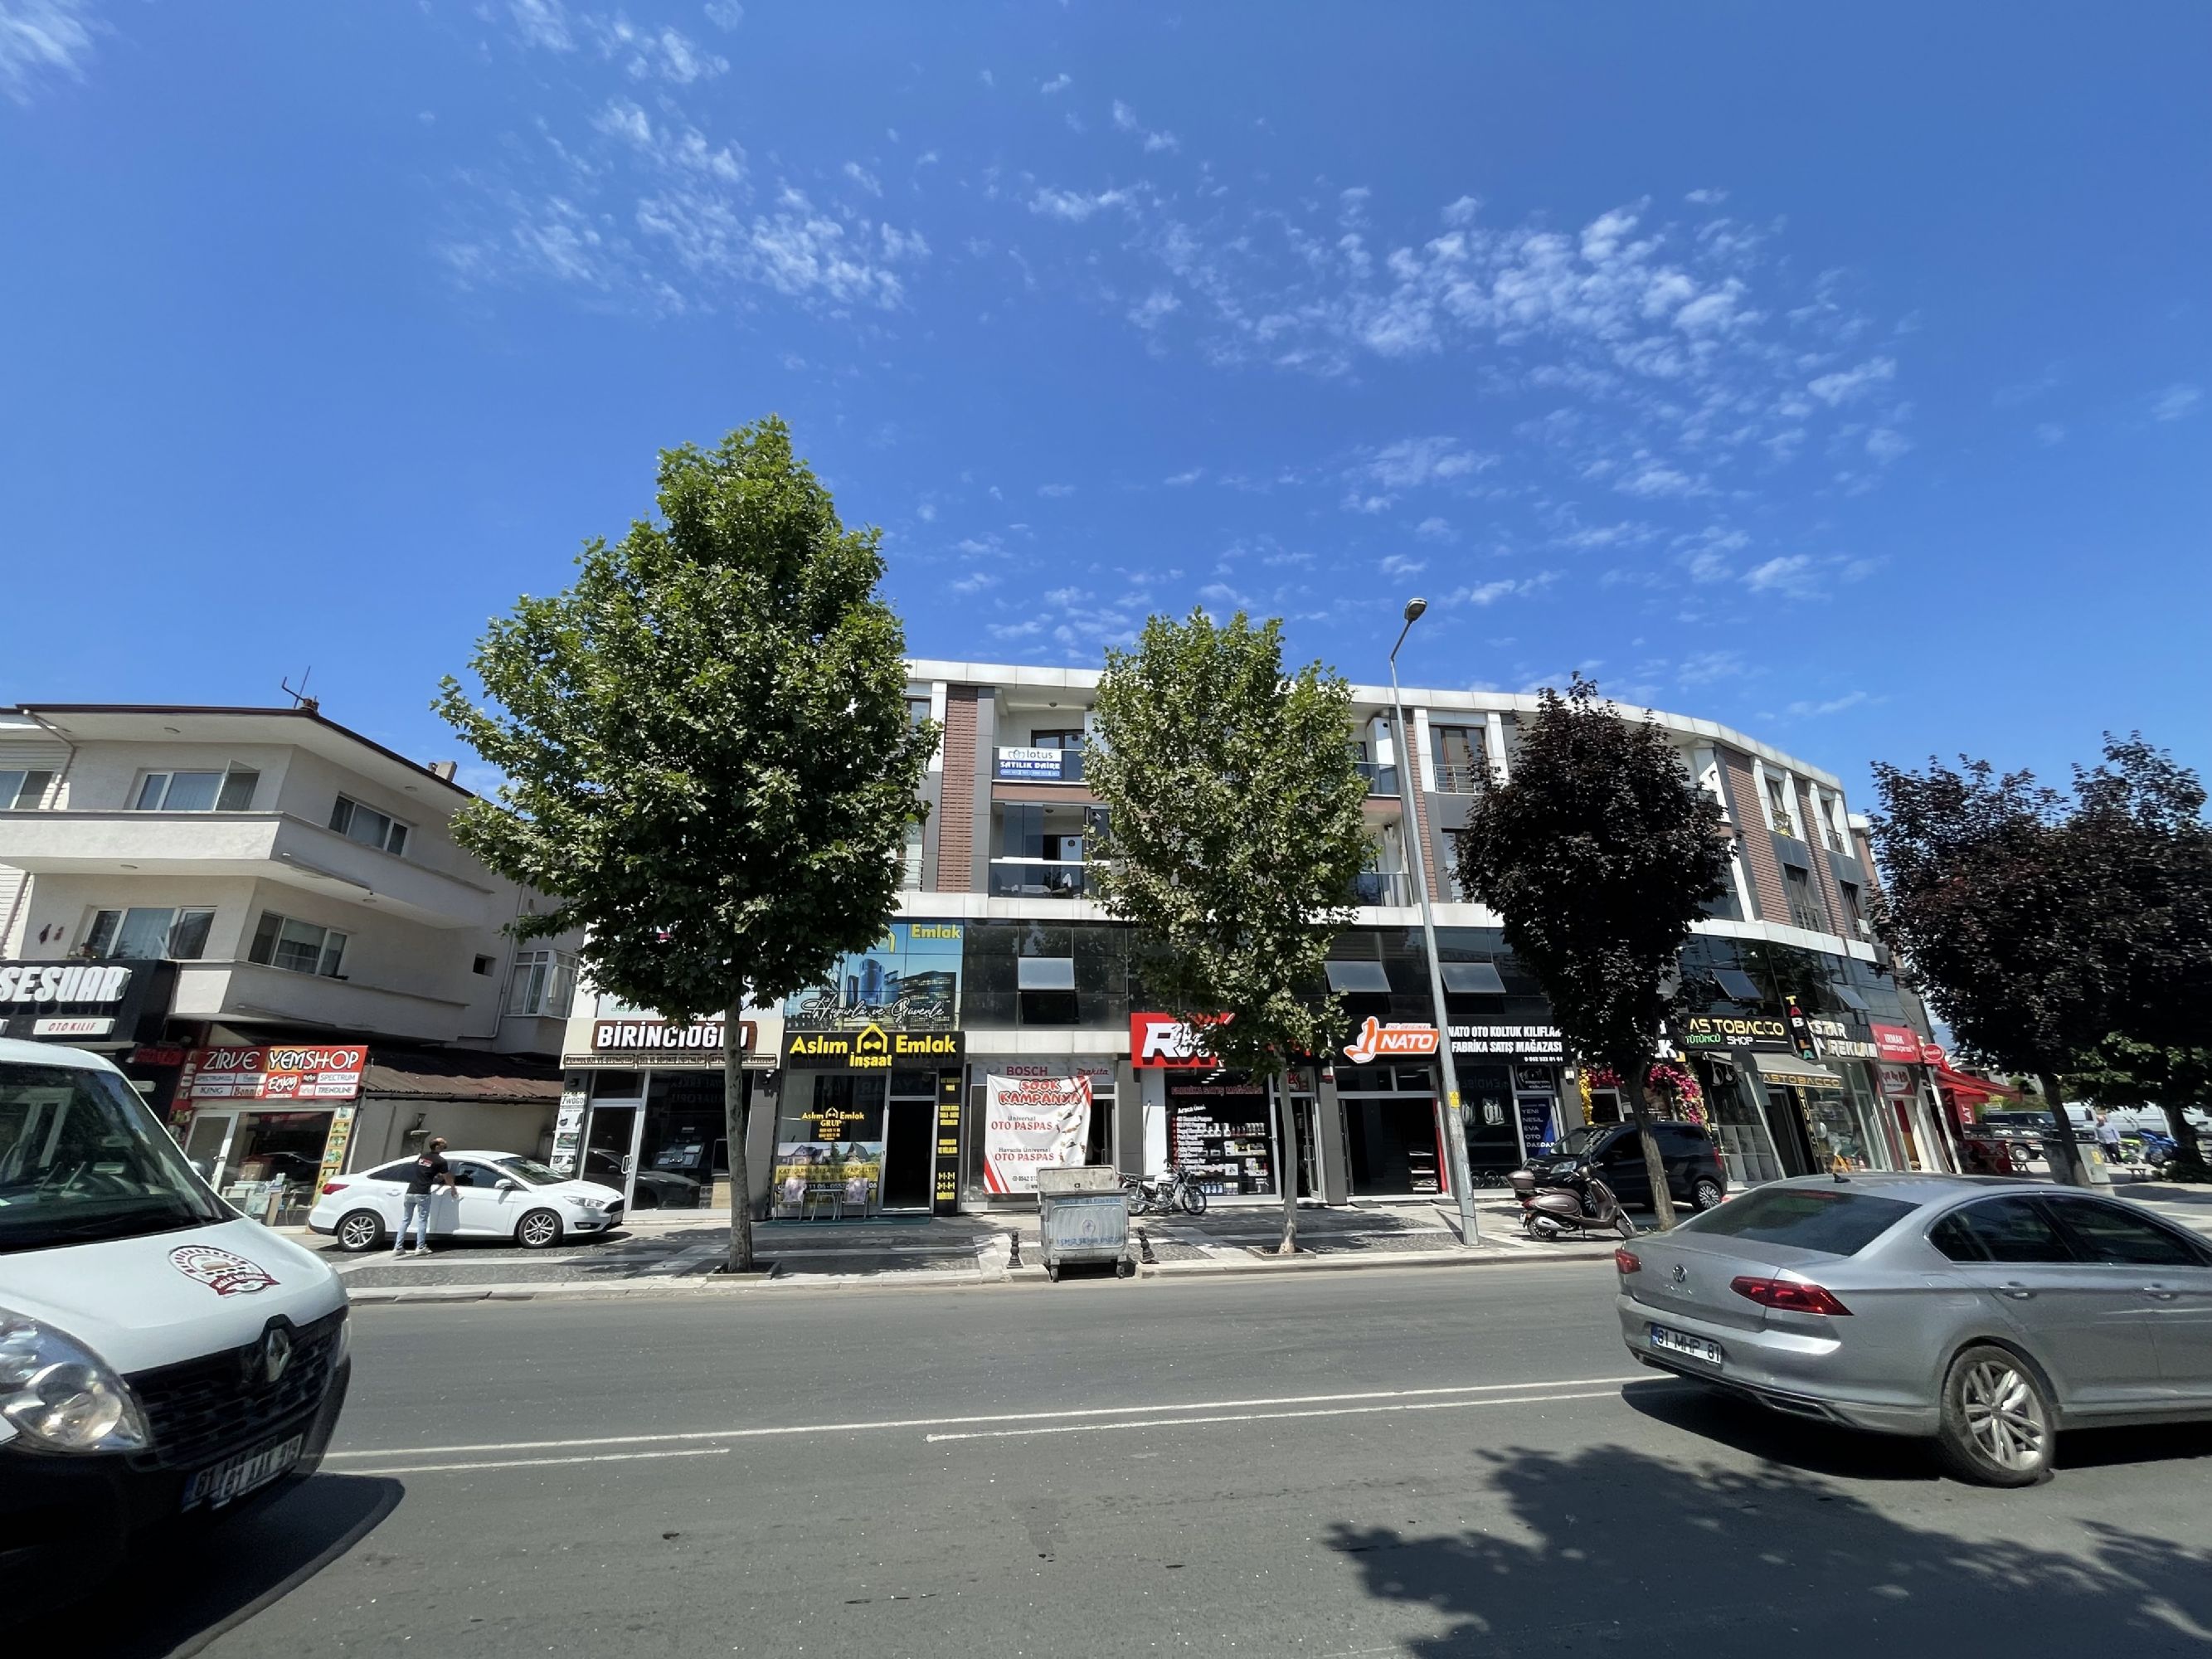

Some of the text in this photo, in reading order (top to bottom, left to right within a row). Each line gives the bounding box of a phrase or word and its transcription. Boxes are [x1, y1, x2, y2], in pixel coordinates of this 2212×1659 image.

[1027, 751, 1053, 759] lotus
[911, 923, 962, 939] Emlak
[871, 1006, 886, 1016] ve
[48, 1023, 68, 1031] OTO
[1471, 1026, 1489, 1037] OTO
[1490, 1026, 1522, 1037] KOLTUK
[1689, 1018, 1785, 1036] AS TOBACCO
[790, 1034, 957, 1054] Aslım Emlak
[1380, 1034, 1434, 1049] NATO
[1451, 1039, 1563, 1053] FABRİKA SATIŞ MAĞAZASI
[1727, 1036, 1754, 1046] SHOP
[203, 1048, 260, 1070] ZİRVE
[268, 1050, 360, 1070] YEMSHOP
[849, 1051, 892, 1068] İnşaat
[1006, 1066, 1048, 1076] BOSCH
[999, 1091, 1082, 1105] KAMPANYA
[839, 1112, 865, 1120] Emlak
[991, 1121, 1053, 1131] OTO PASPAS
[994, 1152, 1054, 1161] OTO PASPAS
[1659, 1329, 1719, 1362] 81 MHP 81
